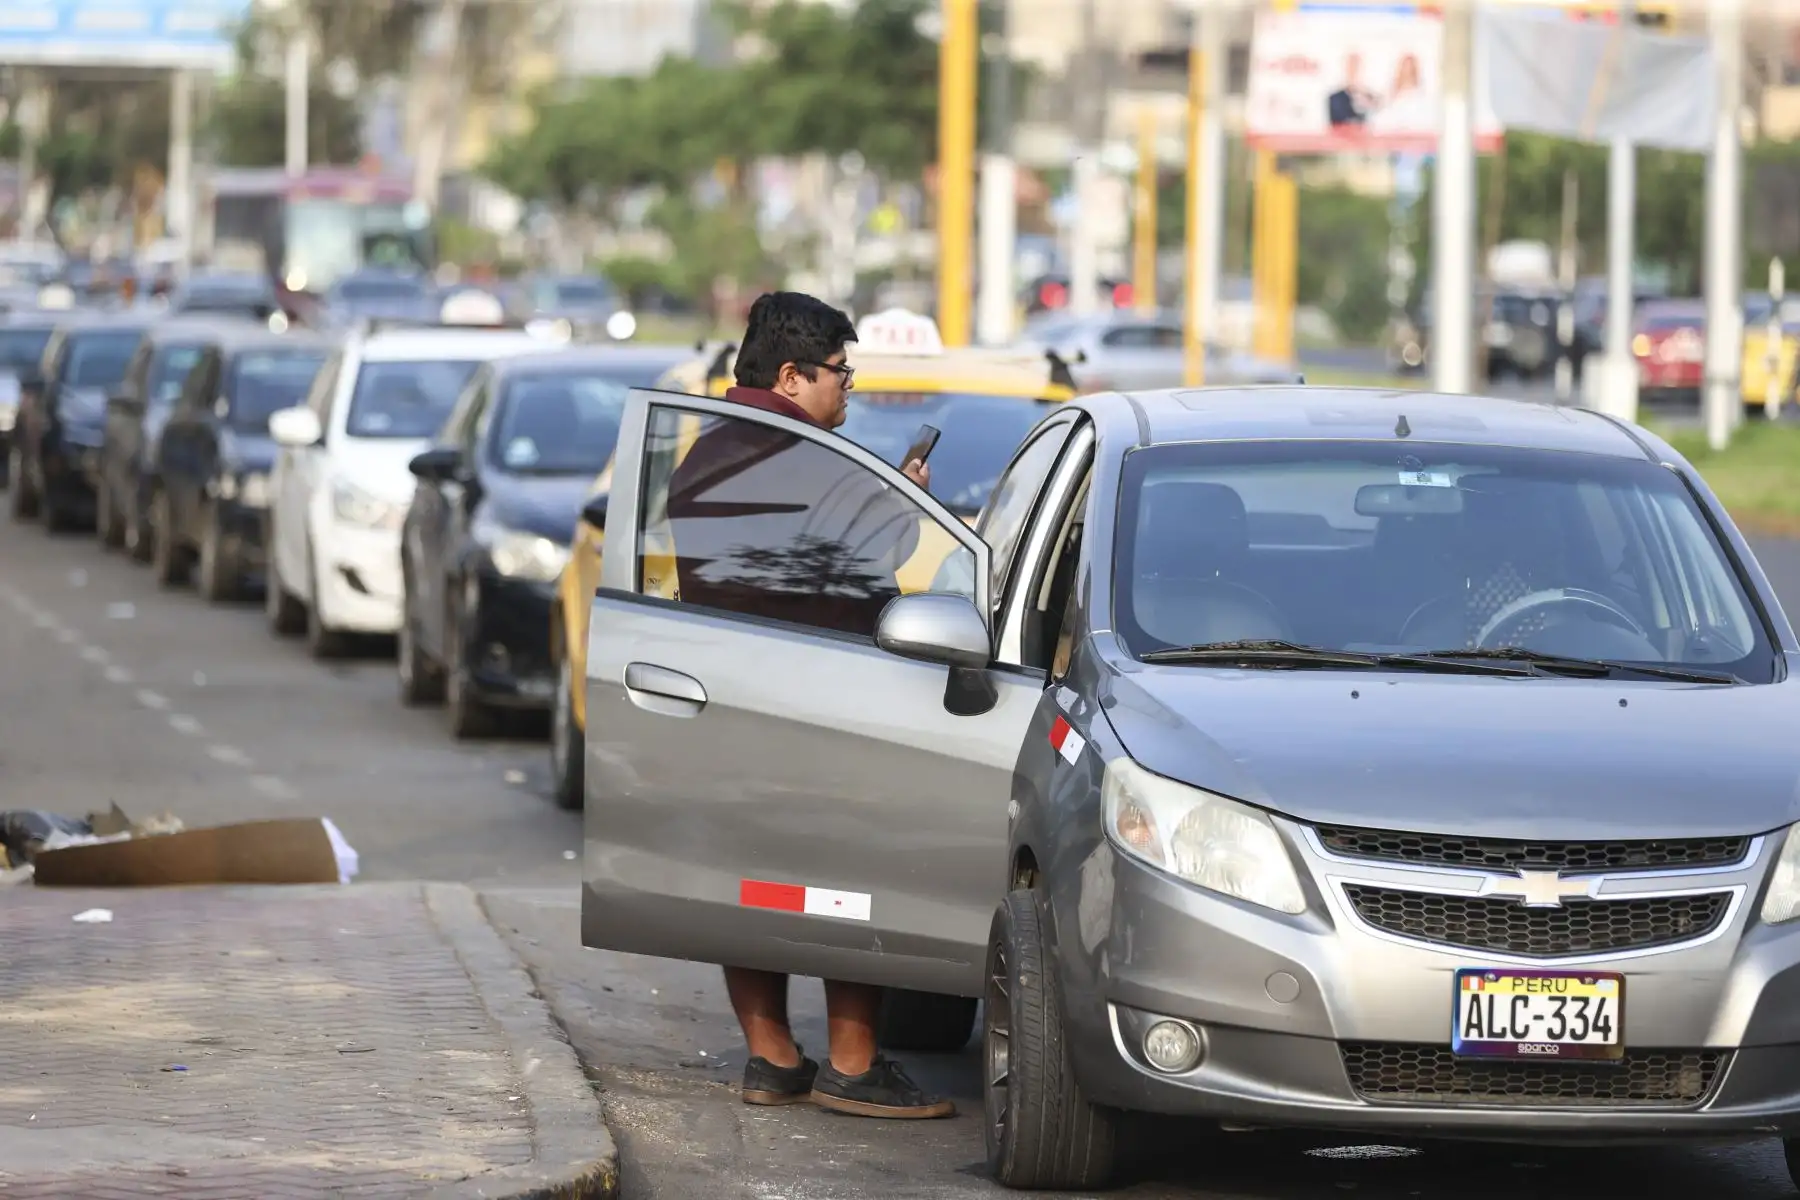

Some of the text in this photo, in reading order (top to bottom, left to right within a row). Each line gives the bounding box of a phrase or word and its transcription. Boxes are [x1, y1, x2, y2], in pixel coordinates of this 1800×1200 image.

[1512, 978, 1567, 992] PERU
[1464, 994, 1612, 1042] ALC-334
[1518, 1043, 1560, 1054] sparco
